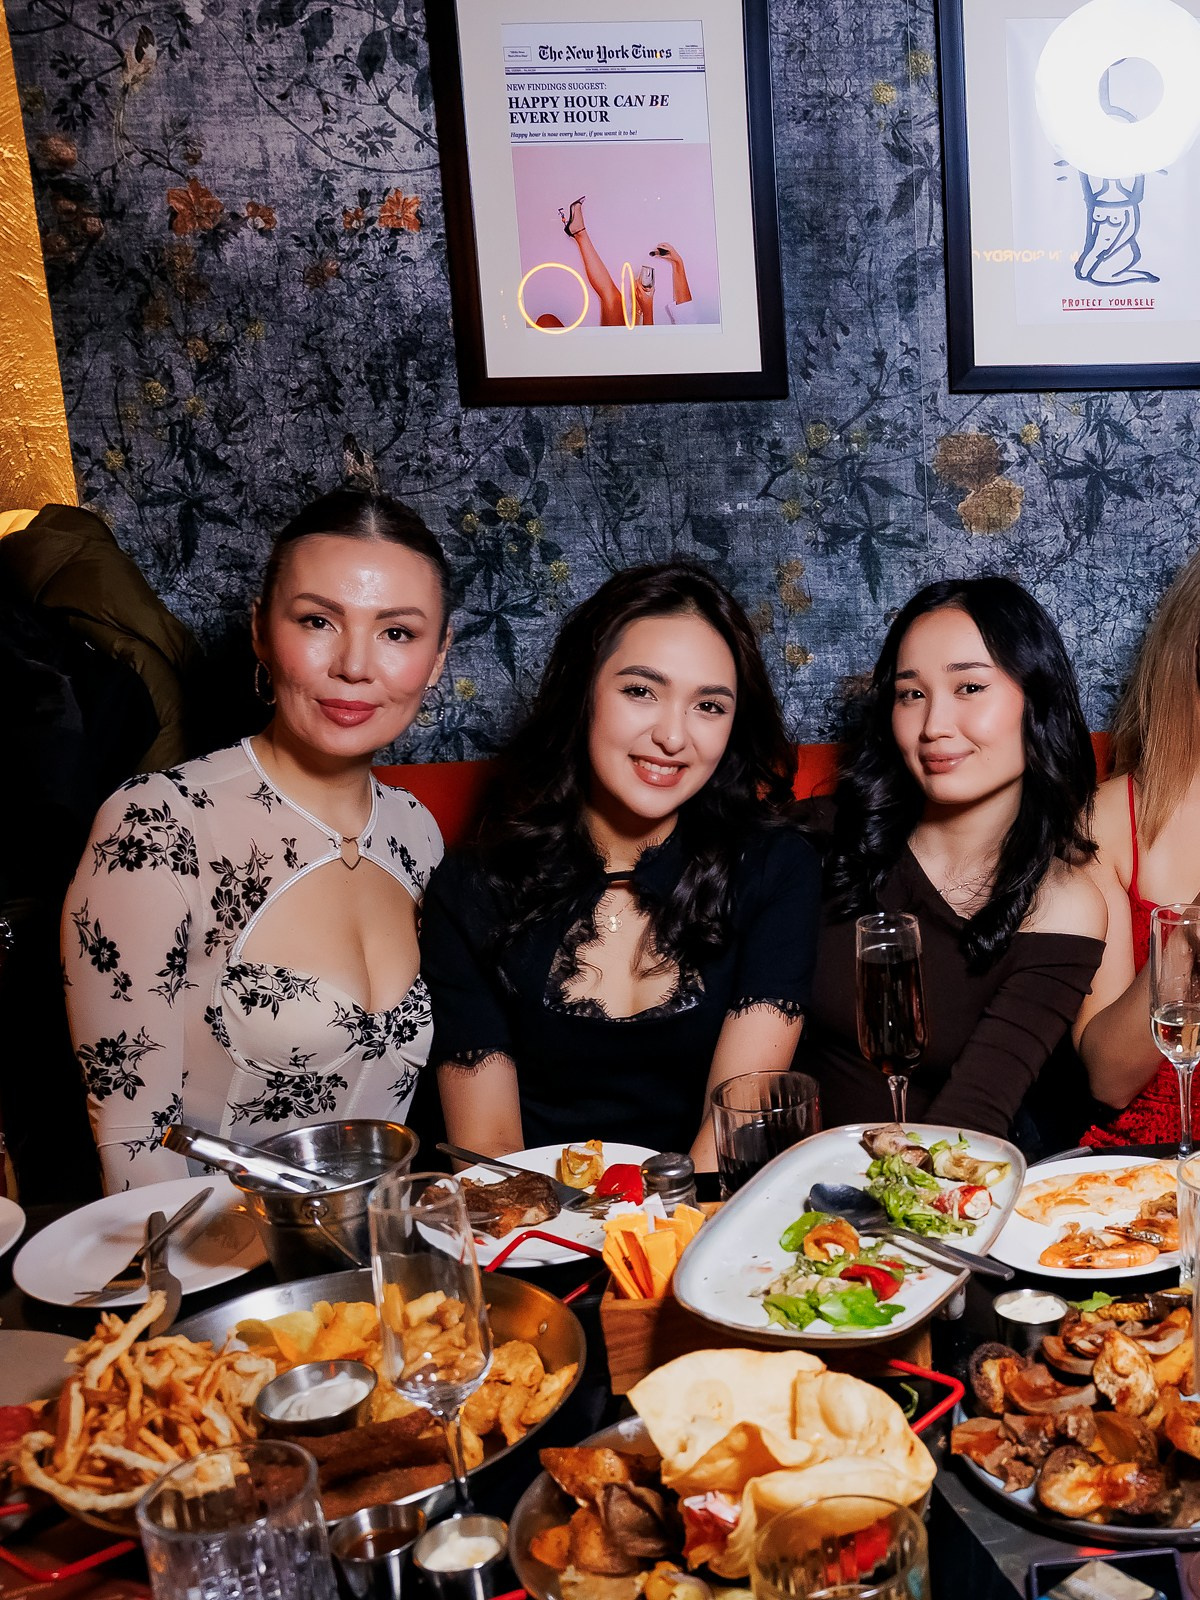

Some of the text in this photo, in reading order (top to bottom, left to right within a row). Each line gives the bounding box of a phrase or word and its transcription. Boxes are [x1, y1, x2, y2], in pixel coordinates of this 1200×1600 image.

[538, 44, 564, 62] The
[566, 45, 594, 61] New
[597, 45, 630, 63] York
[631, 43, 673, 60] Times
[506, 82, 607, 92] NEW FINDINGS SUGGEST:
[508, 94, 670, 109] HAPPY HOUR CAN BE
[509, 110, 610, 124] EVERY HOUR
[1061, 298, 1155, 308] PROTECT YOURSELF
